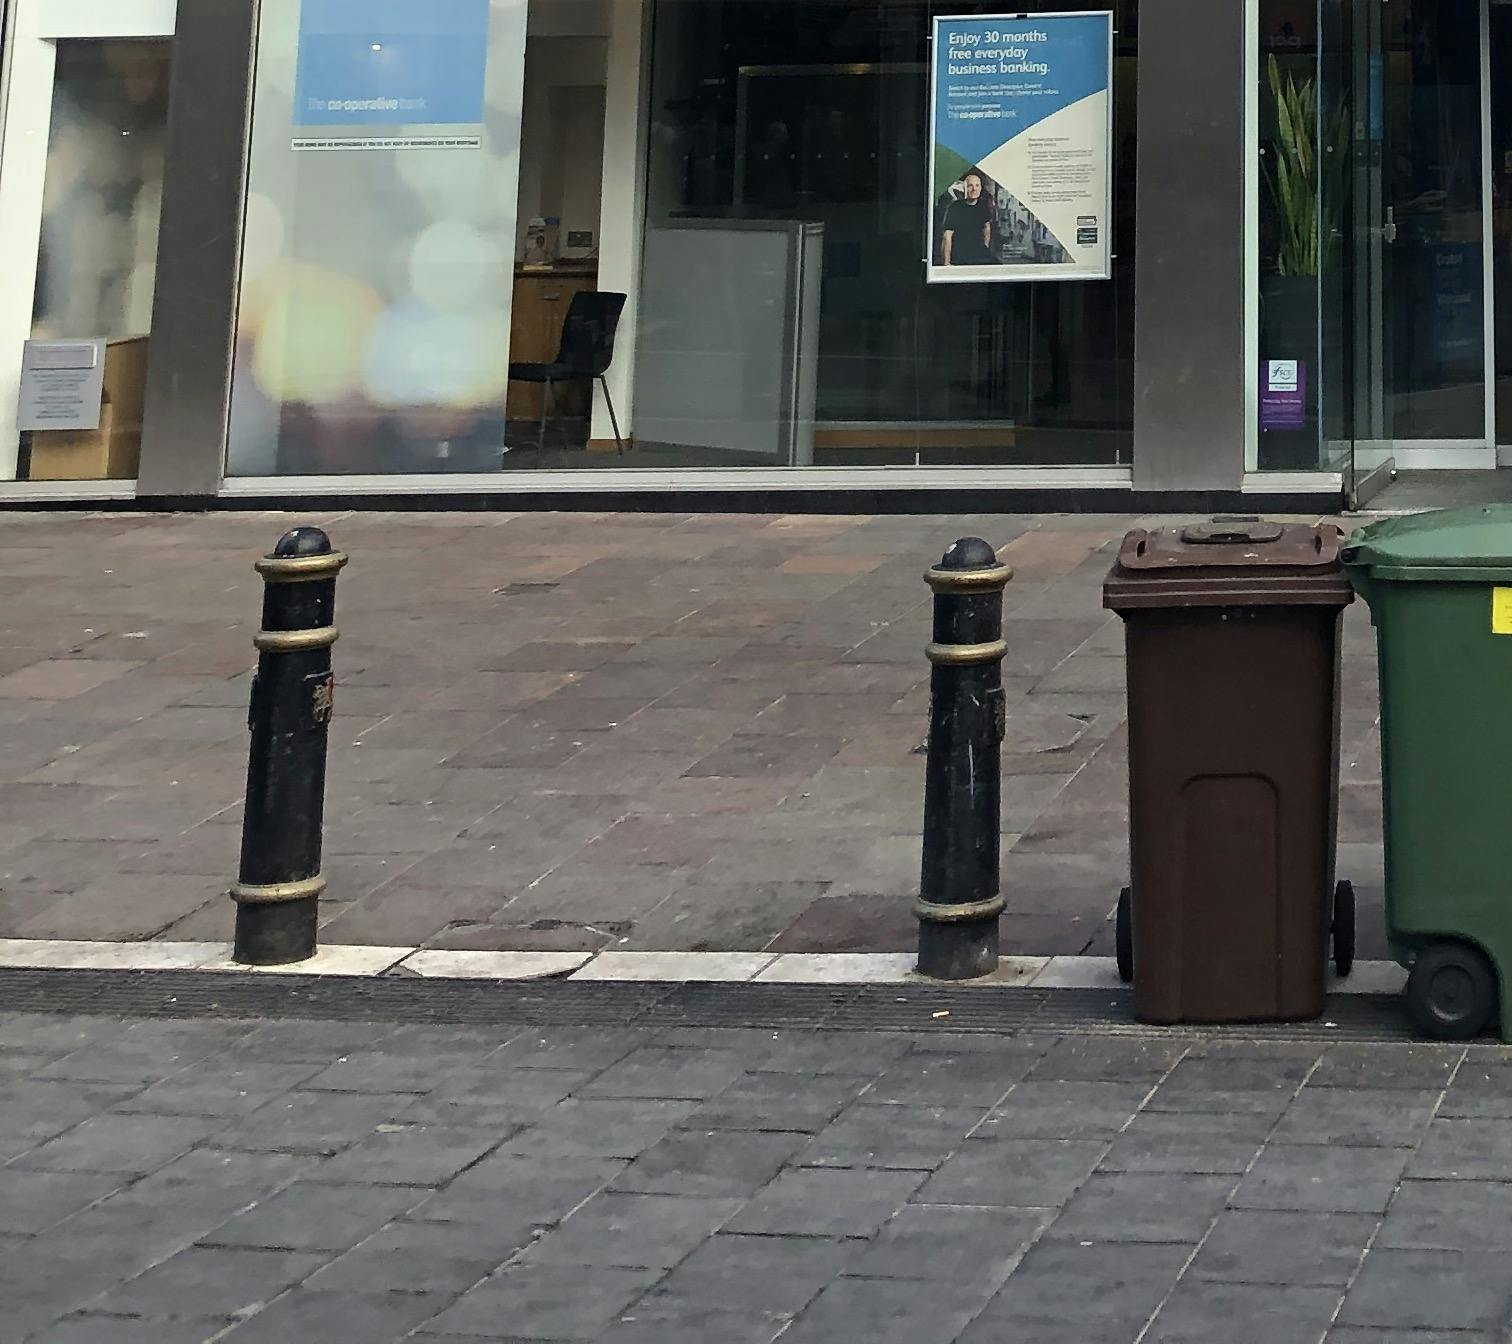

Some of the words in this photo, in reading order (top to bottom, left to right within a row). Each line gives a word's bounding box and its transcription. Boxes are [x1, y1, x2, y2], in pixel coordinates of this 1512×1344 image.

[949, 31, 981, 47] Enjoy
[984, 31, 1000, 44] 30
[1002, 30, 1048, 43] months
[949, 47, 972, 60] free
[975, 47, 1028, 61] everyday
[948, 62, 997, 75] business
[1000, 61, 1050, 76] banking.
[327, 97, 399, 112] co-operative
